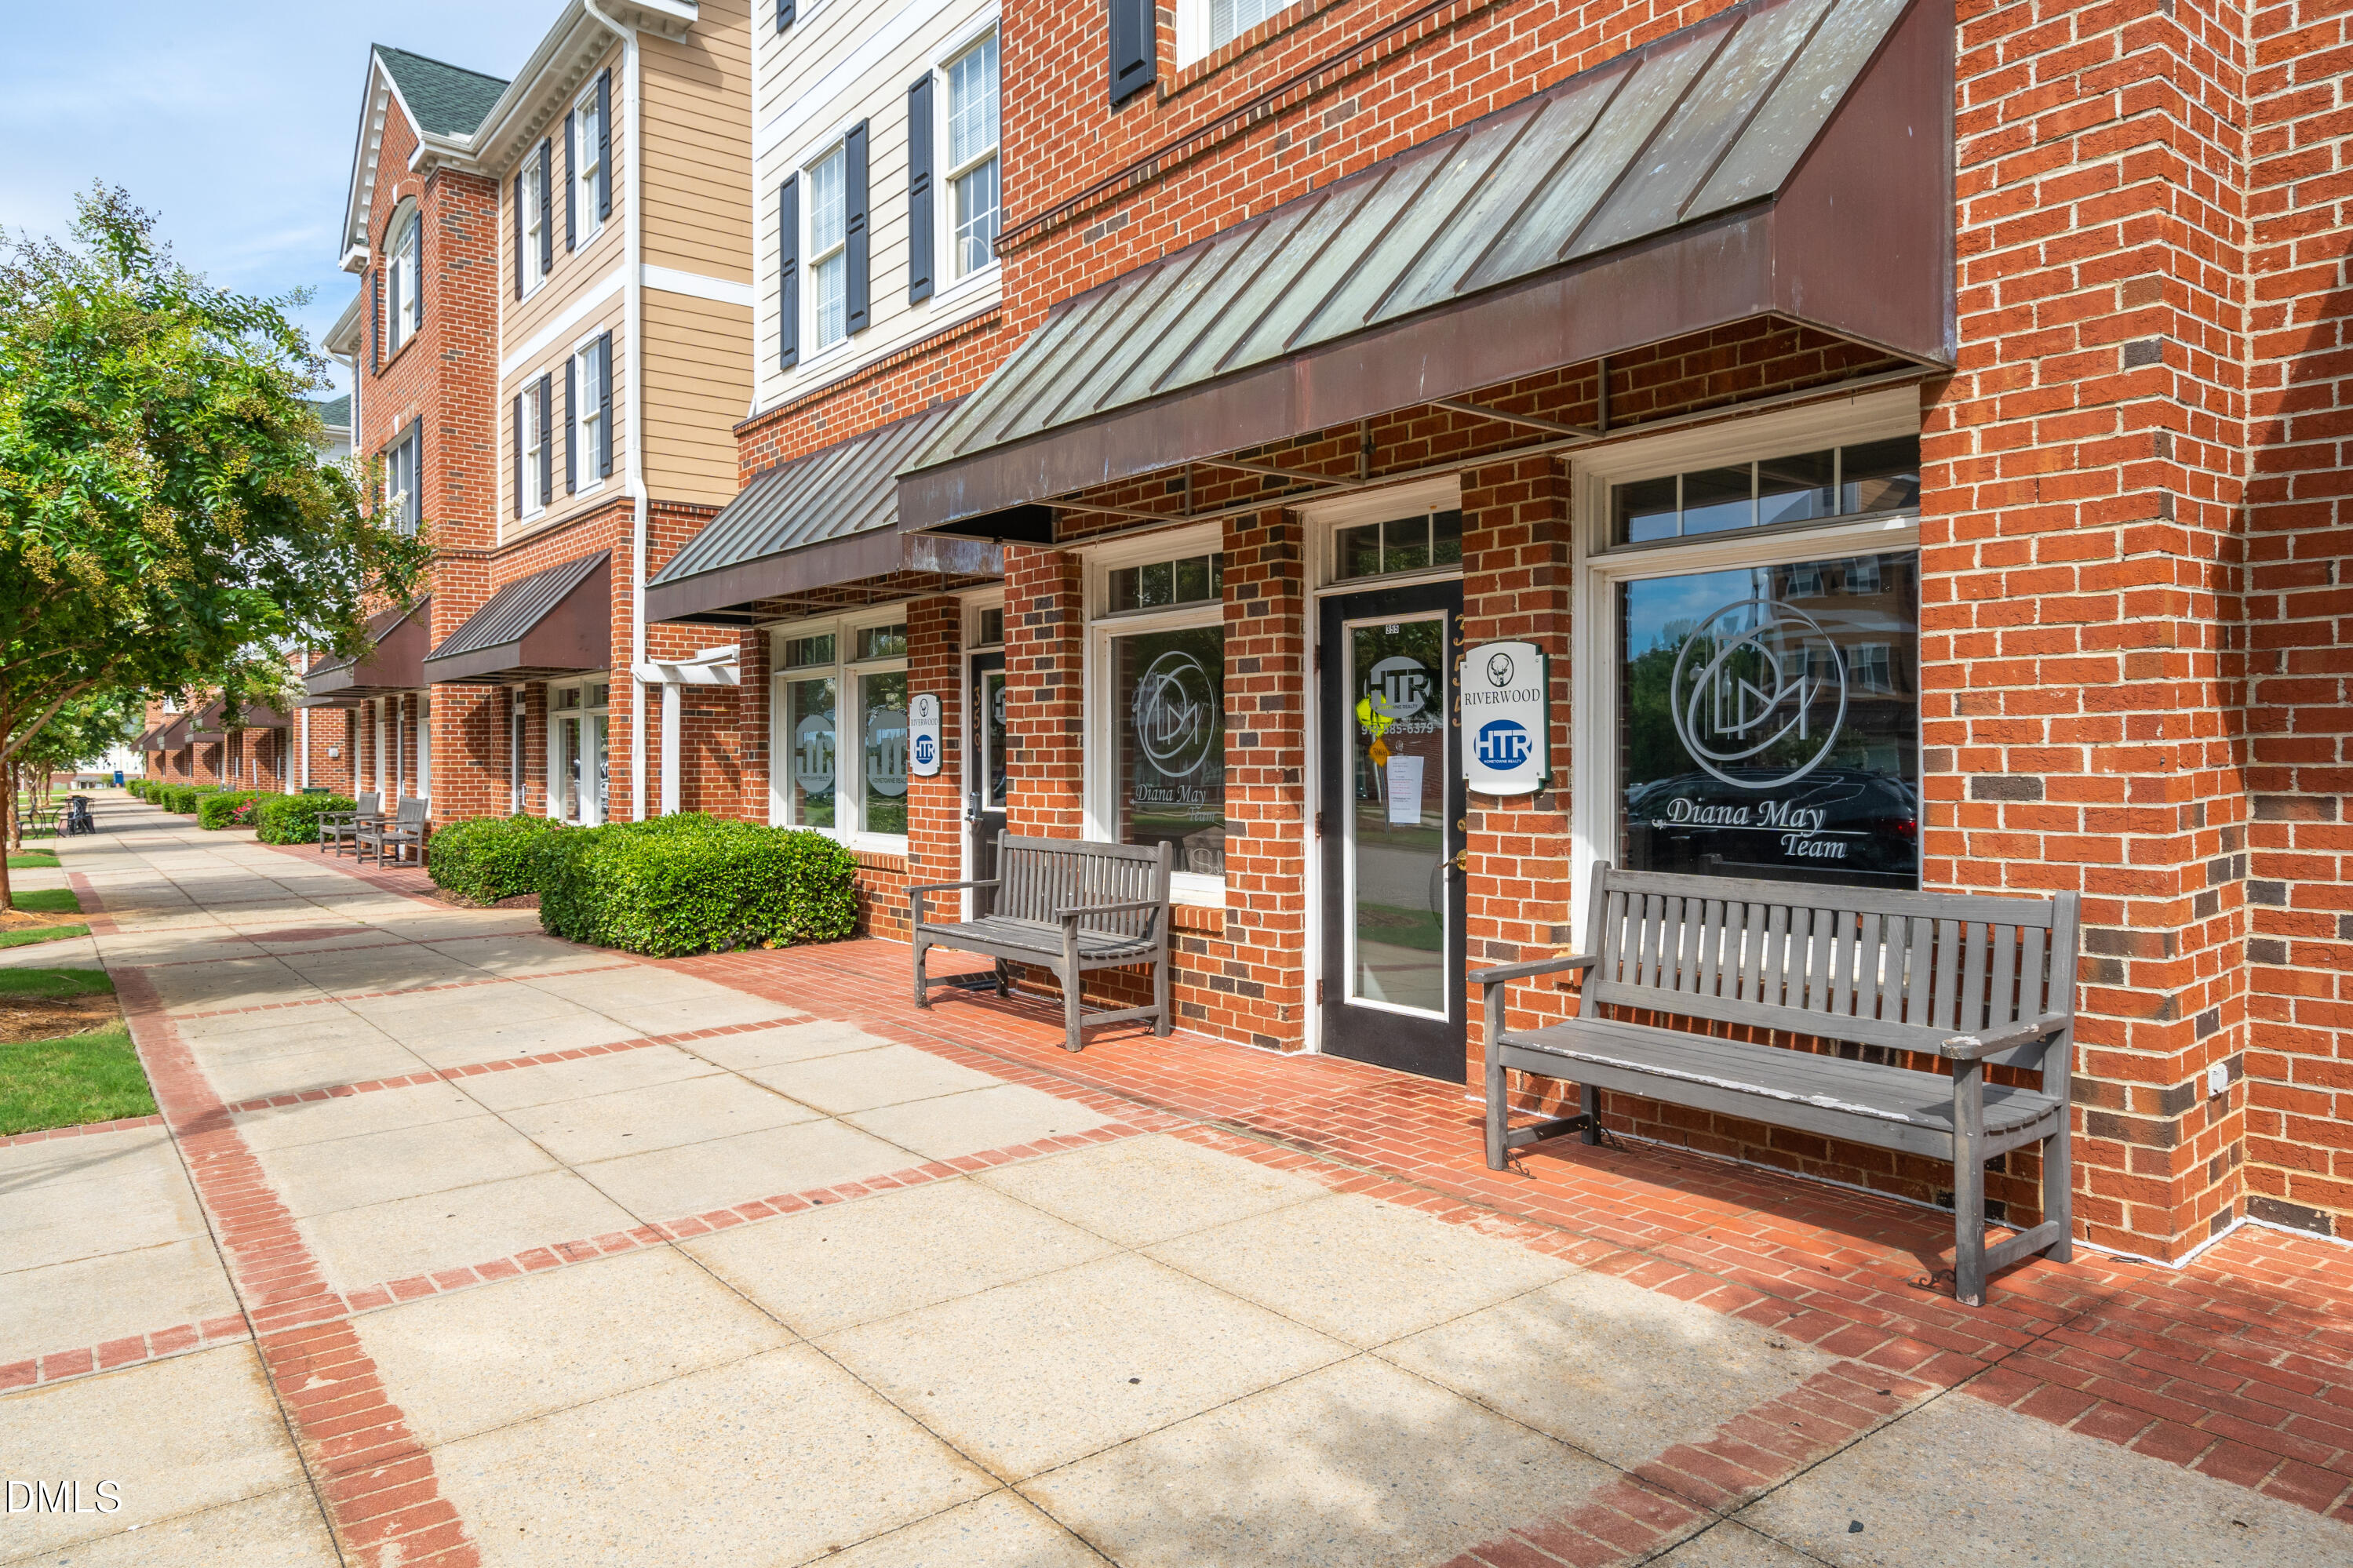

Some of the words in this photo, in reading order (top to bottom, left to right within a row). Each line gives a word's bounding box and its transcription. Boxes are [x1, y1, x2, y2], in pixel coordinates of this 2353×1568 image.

[1386, 625, 1399, 634] 355
[1367, 668, 1427, 704] HTR
[1465, 688, 1540, 706] RIVERWOOD
[911, 718, 938, 726] RIVERWOOD
[1361, 722, 1434, 736] 919-585-6379
[915, 740, 935, 758] HTR
[1475, 729, 1532, 759] HTR
[1136, 784, 1174, 801] Diana
[1177, 784, 1207, 809] May
[1188, 806, 1215, 822] Team
[1667, 797, 1751, 826] Diana
[1757, 800, 1826, 838] May
[1781, 833, 1847, 859] Team
